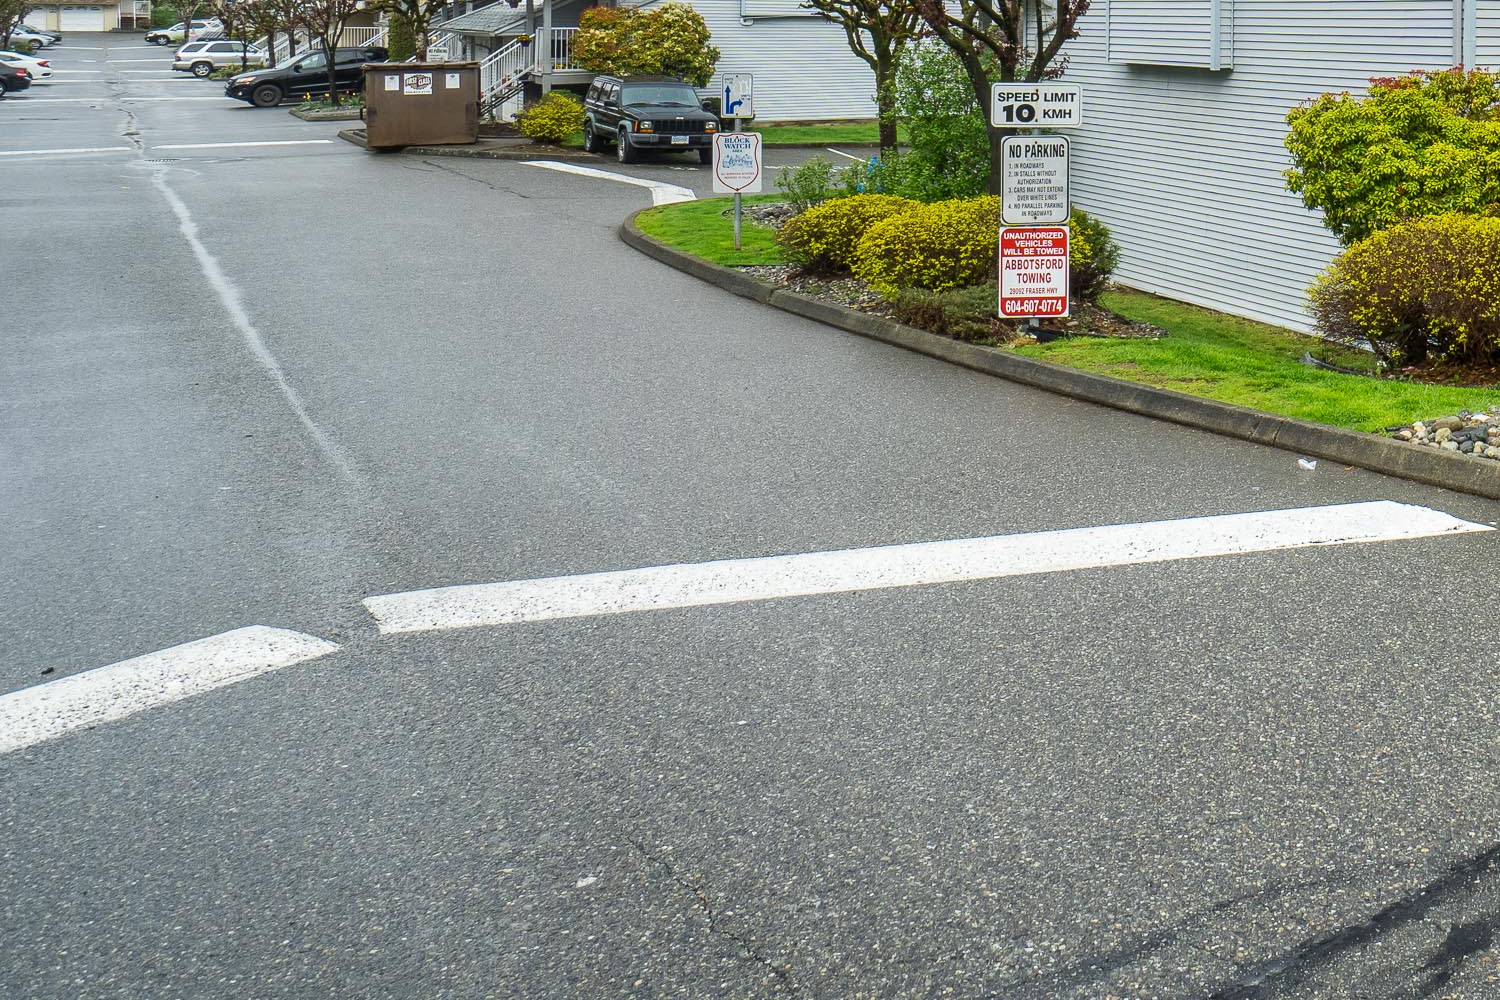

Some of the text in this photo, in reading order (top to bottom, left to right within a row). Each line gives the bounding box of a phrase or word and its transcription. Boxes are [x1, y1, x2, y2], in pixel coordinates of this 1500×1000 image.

[997, 92, 1076, 102] SPEED LIMIT
[1002, 104, 1072, 122] 10 KMH
[1009, 144, 1064, 158] NO PARKING
[1005, 259, 1063, 270] ABBOTSFORD
[1017, 273, 1051, 284] TOWING
[1006, 300, 1062, 313] 604-607-0774
